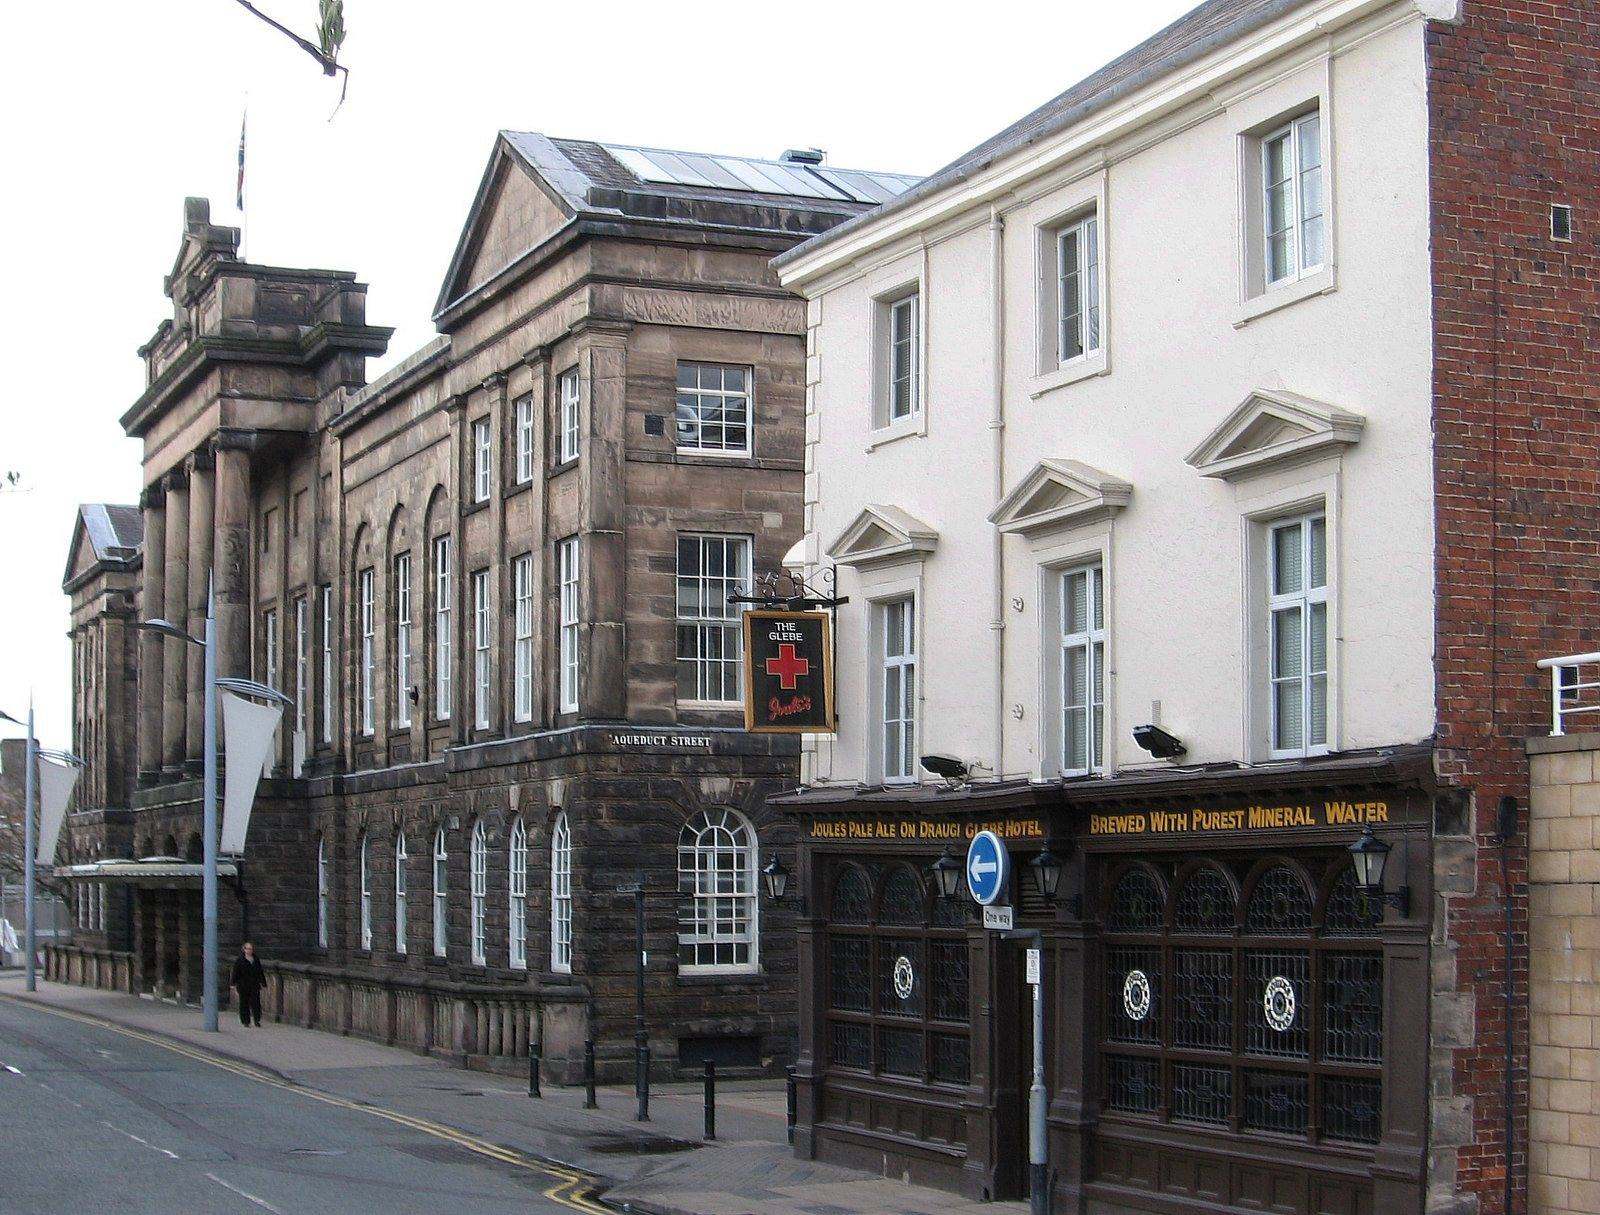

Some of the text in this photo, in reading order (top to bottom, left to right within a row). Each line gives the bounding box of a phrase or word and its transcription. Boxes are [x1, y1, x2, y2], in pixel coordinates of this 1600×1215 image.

[775, 622, 796, 632] THE
[769, 632, 803, 641] GLEBE
[612, 735, 711, 747] AQUEDUCT STREET
[1090, 802, 1388, 834] BREWED WITH PUREST MINERAL WATER
[849, 820, 873, 838] PALE
[875, 820, 896, 838] ALE
[900, 821, 916, 837] ON
[1005, 819, 1042, 837] HOTEL
